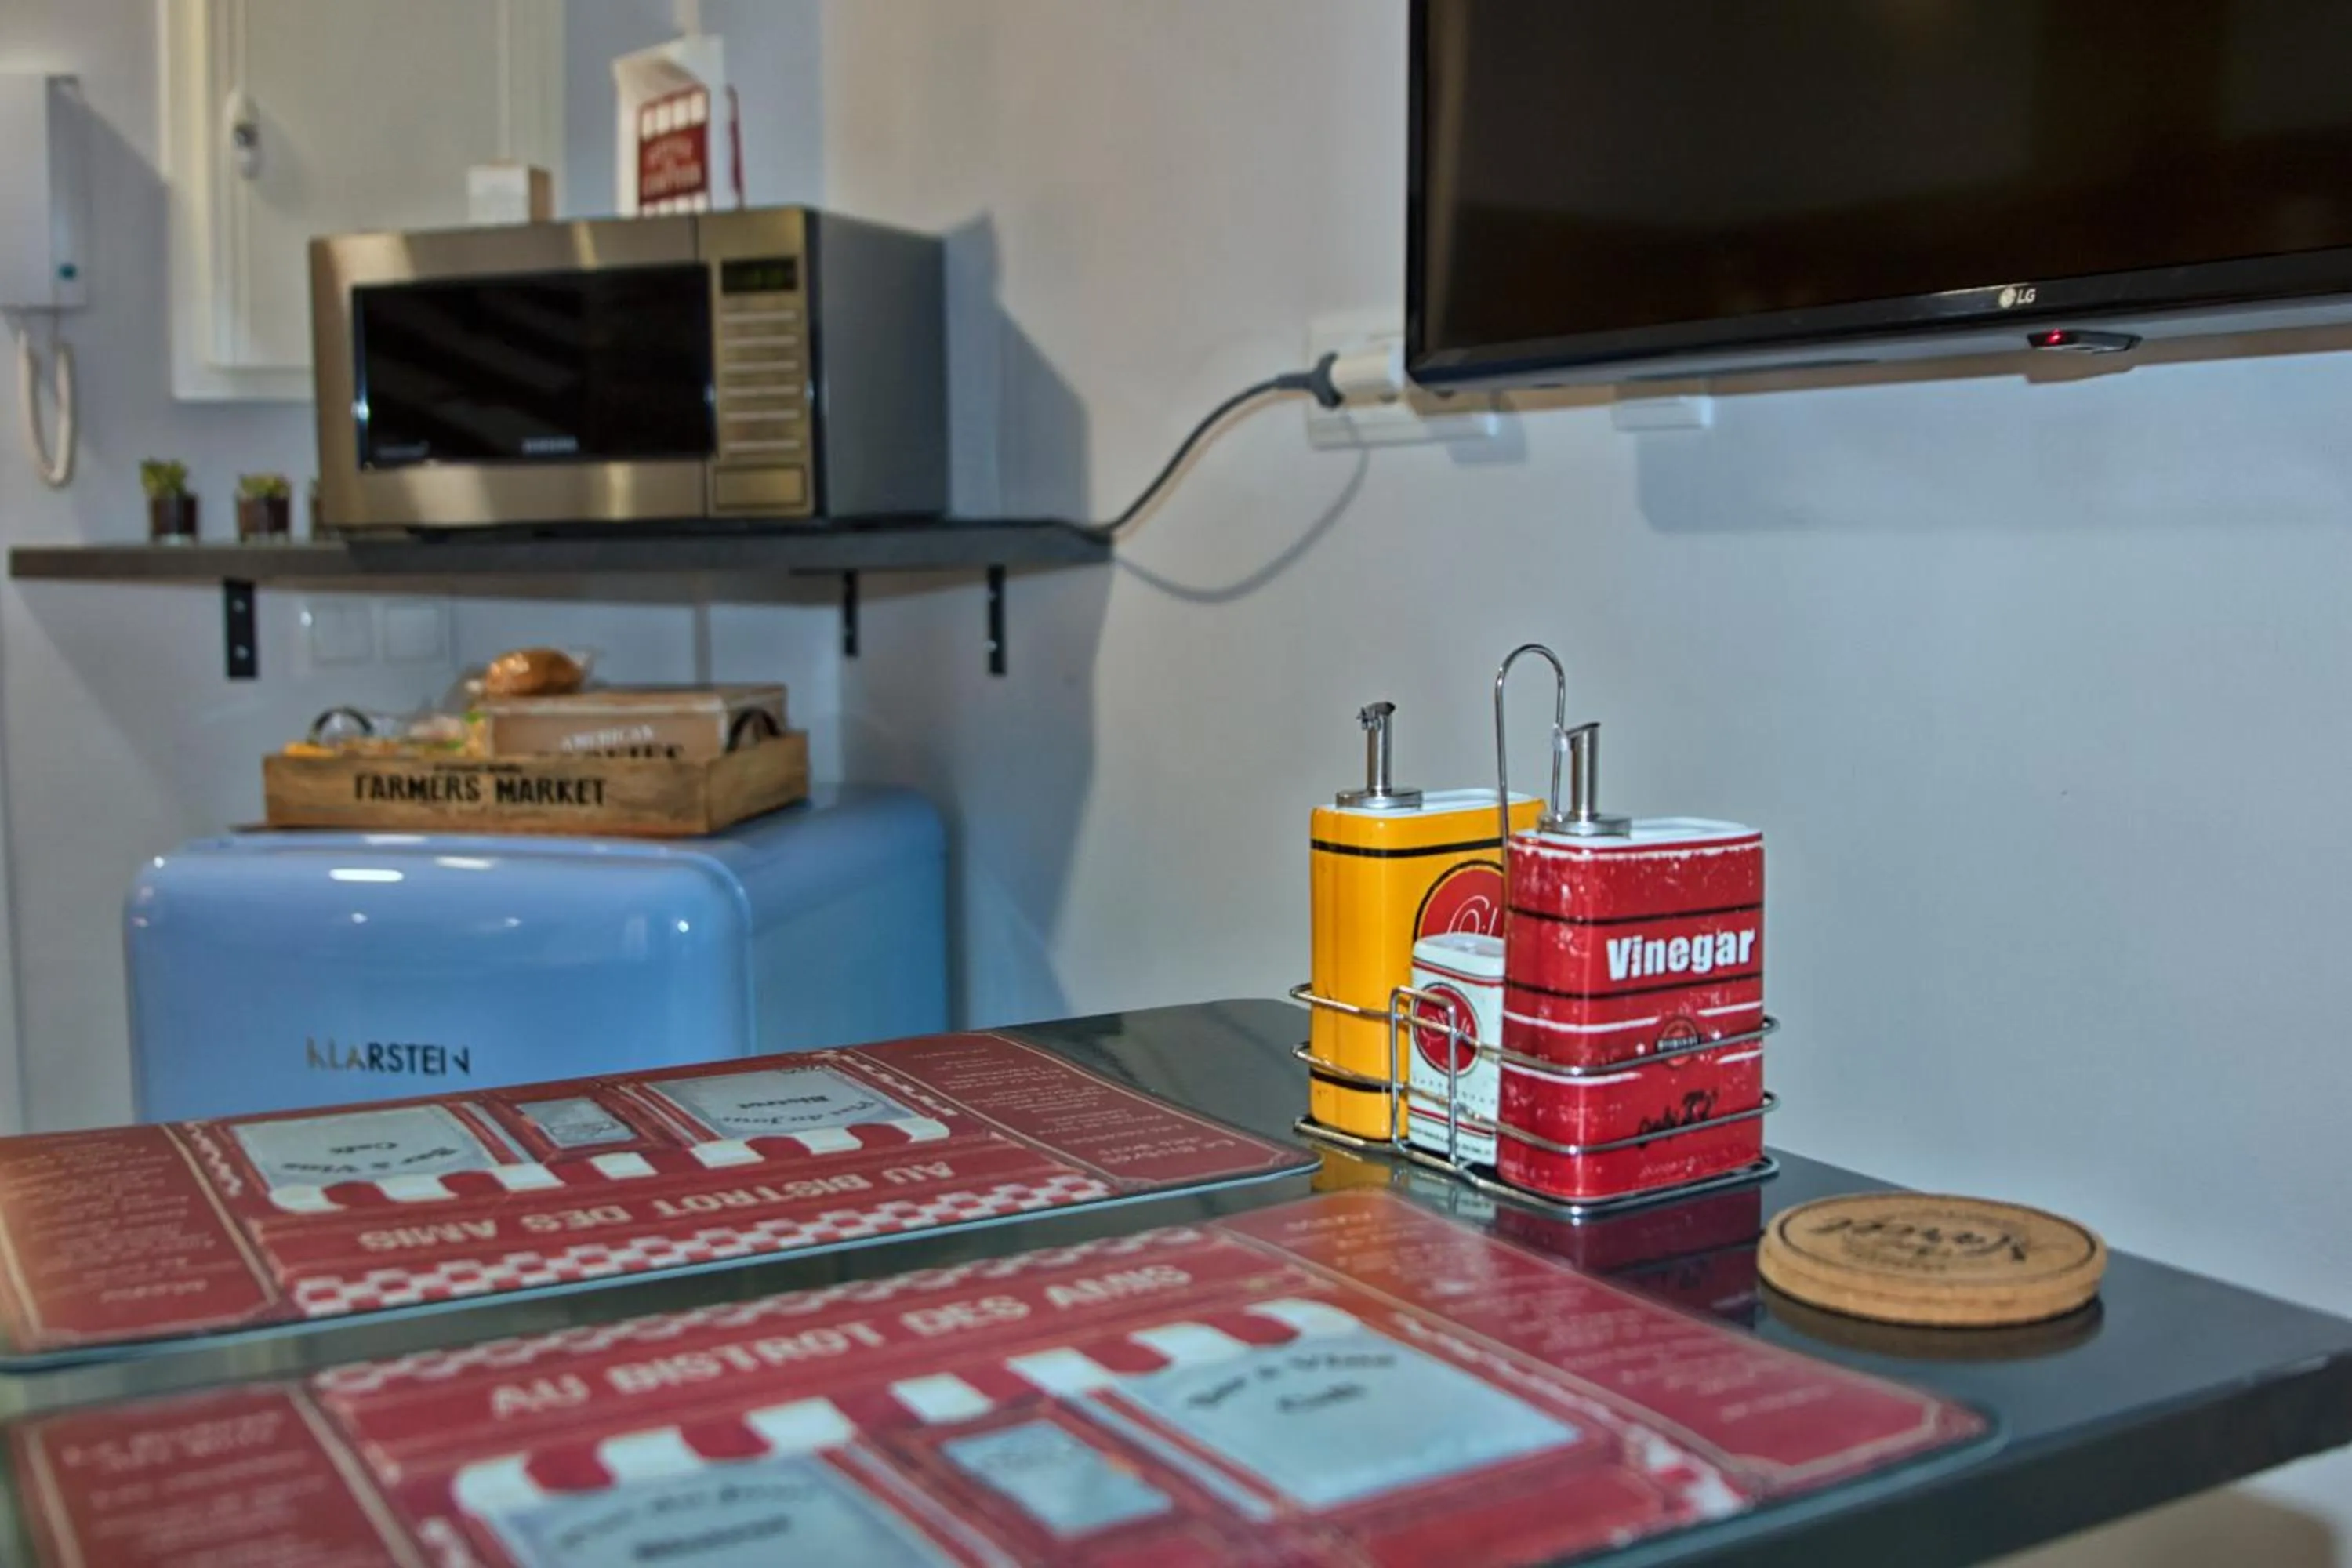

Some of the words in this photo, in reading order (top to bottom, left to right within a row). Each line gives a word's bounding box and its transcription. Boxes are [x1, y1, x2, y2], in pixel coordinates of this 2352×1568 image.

[354, 772, 481, 803] FARMERS
[495, 776, 607, 806] MARKET
[1606, 928, 1755, 981] Vinegar
[891, 1161, 956, 1186] AU
[652, 1173, 873, 1218] BISTROT
[358, 1219, 499, 1251] AMIS
[520, 1204, 633, 1233] DES
[490, 1374, 590, 1419] AU
[606, 1320, 887, 1394] BISTROT
[900, 1294, 1030, 1335] DES
[1044, 1264, 1192, 1309] AMIS
